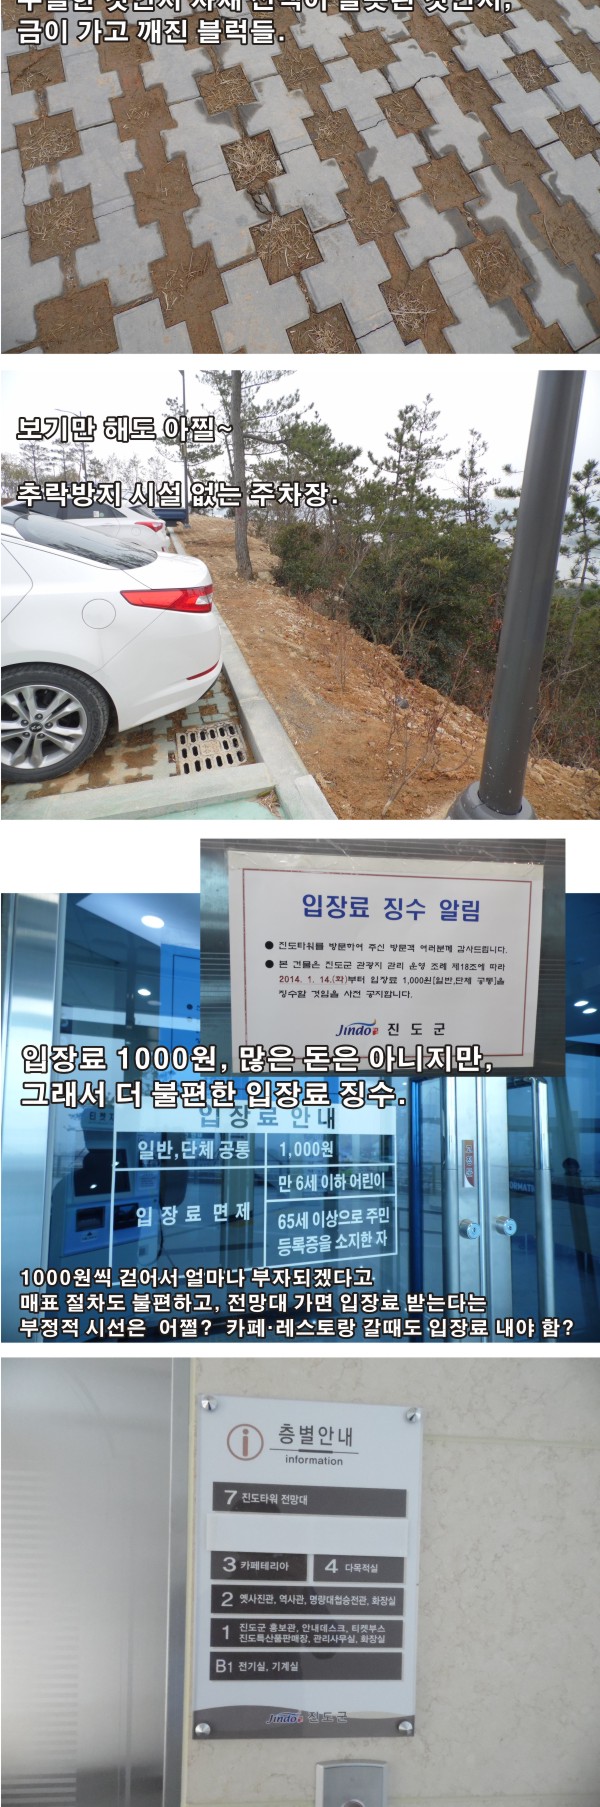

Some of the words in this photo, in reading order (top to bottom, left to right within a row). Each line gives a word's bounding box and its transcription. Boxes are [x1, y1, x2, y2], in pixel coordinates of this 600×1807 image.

[302, 894, 370, 919] 입장료
[384, 898, 426, 921] 징수
[440, 900, 480, 922] 알림
[138, 1140, 214, 1160] 일반,단체
[219, 1140, 250, 1160] 공통
[280, 1141, 333, 1158] 1,000원
[279, 1175, 292, 1192] 만
[296, 1174, 317, 1192] 6세
[321, 1173, 346, 1191] 이하
[350, 1172, 385, 1189] 어린이
[278, 1212, 308, 1230] 65세
[313, 1208, 363, 1228] 이상으로
[366, 1207, 389, 1224] 주민
[278, 1235, 332, 1256] 등록증을
[335, 1231, 372, 1250] 소지한
[376, 1230, 387, 1246] 자
[279, 1423, 352, 1447] 층별안내
[285, 1455, 343, 1466] information
[224, 1490, 237, 1505] 7
[242, 1493, 278, 1504] 진도타워
[281, 1495, 308, 1506] 전망대
[223, 1557, 236, 1572] 3
[241, 1561, 289, 1571] 카페테리아
[324, 1559, 338, 1573] 4
[345, 1563, 378, 1573] 다목적실
[221, 1592, 233, 1607] 2
[279, 1595, 306, 1605] 역사관,
[372, 1596, 396, 1606] 화장실
[222, 1624, 229, 1639] 1
[240, 1623, 266, 1632] 진도군
[269, 1623, 298, 1633] 홍보관,
[352, 1624, 385, 1633] 티켓부스
[239, 1634, 310, 1644] 진도특산품판매장,
[313, 1635, 357, 1644] 관리사무실,
[360, 1635, 385, 1644] 화장실
[216, 1660, 233, 1673] B1
[239, 1662, 268, 1672] 전기실,
[272, 1662, 298, 1672] 기계실
